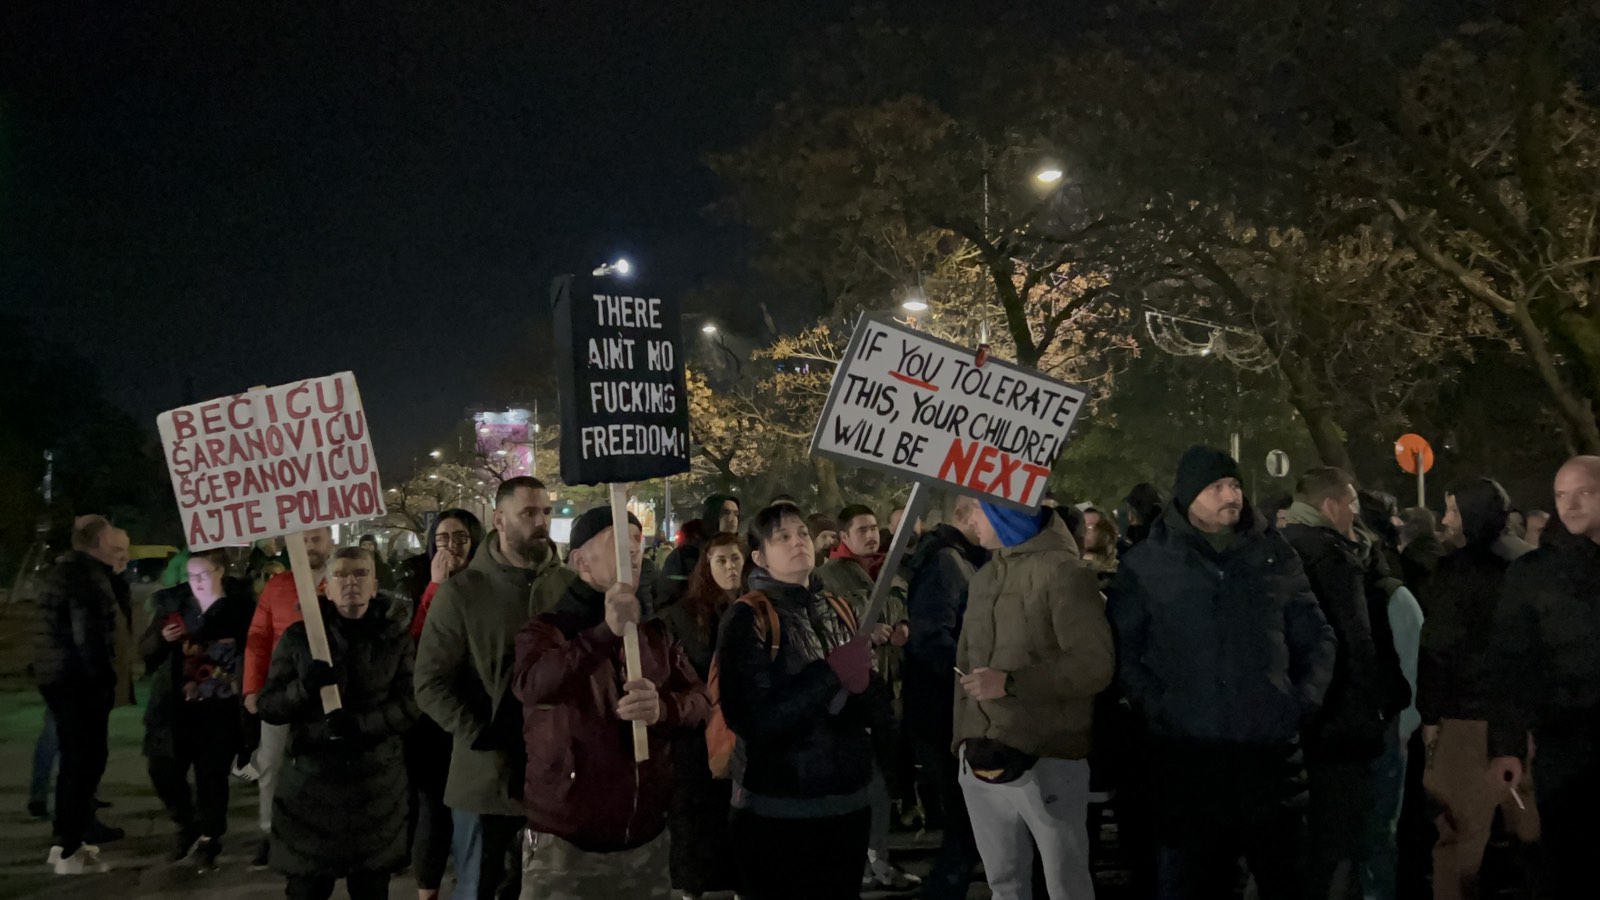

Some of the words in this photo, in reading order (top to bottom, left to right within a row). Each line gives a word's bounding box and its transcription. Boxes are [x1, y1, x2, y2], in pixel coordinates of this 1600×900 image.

[593, 294, 662, 329] THERE
[647, 340, 674, 371] NO
[857, 328, 888, 361] IF
[896, 339, 944, 383] YOU
[950, 359, 1079, 428] TOLERATE
[171, 377, 345, 441] BEČIĆU
[590, 381, 676, 414] FUCKING
[842, 373, 900, 424] THIS,
[911, 391, 969, 437] YOUR
[968, 412, 1063, 469] CHILDREN
[172, 410, 364, 477] ŠARANOVIĆU
[581, 424, 686, 460] FREEDOM!
[834, 414, 885, 458] WILL
[892, 431, 929, 468] BE
[937, 438, 1050, 505] NEXT
[180, 444, 369, 509] ŠĆEPANOVIĆU
[189, 500, 267, 545] AJTE
[275, 471, 384, 530] POLAKO!
